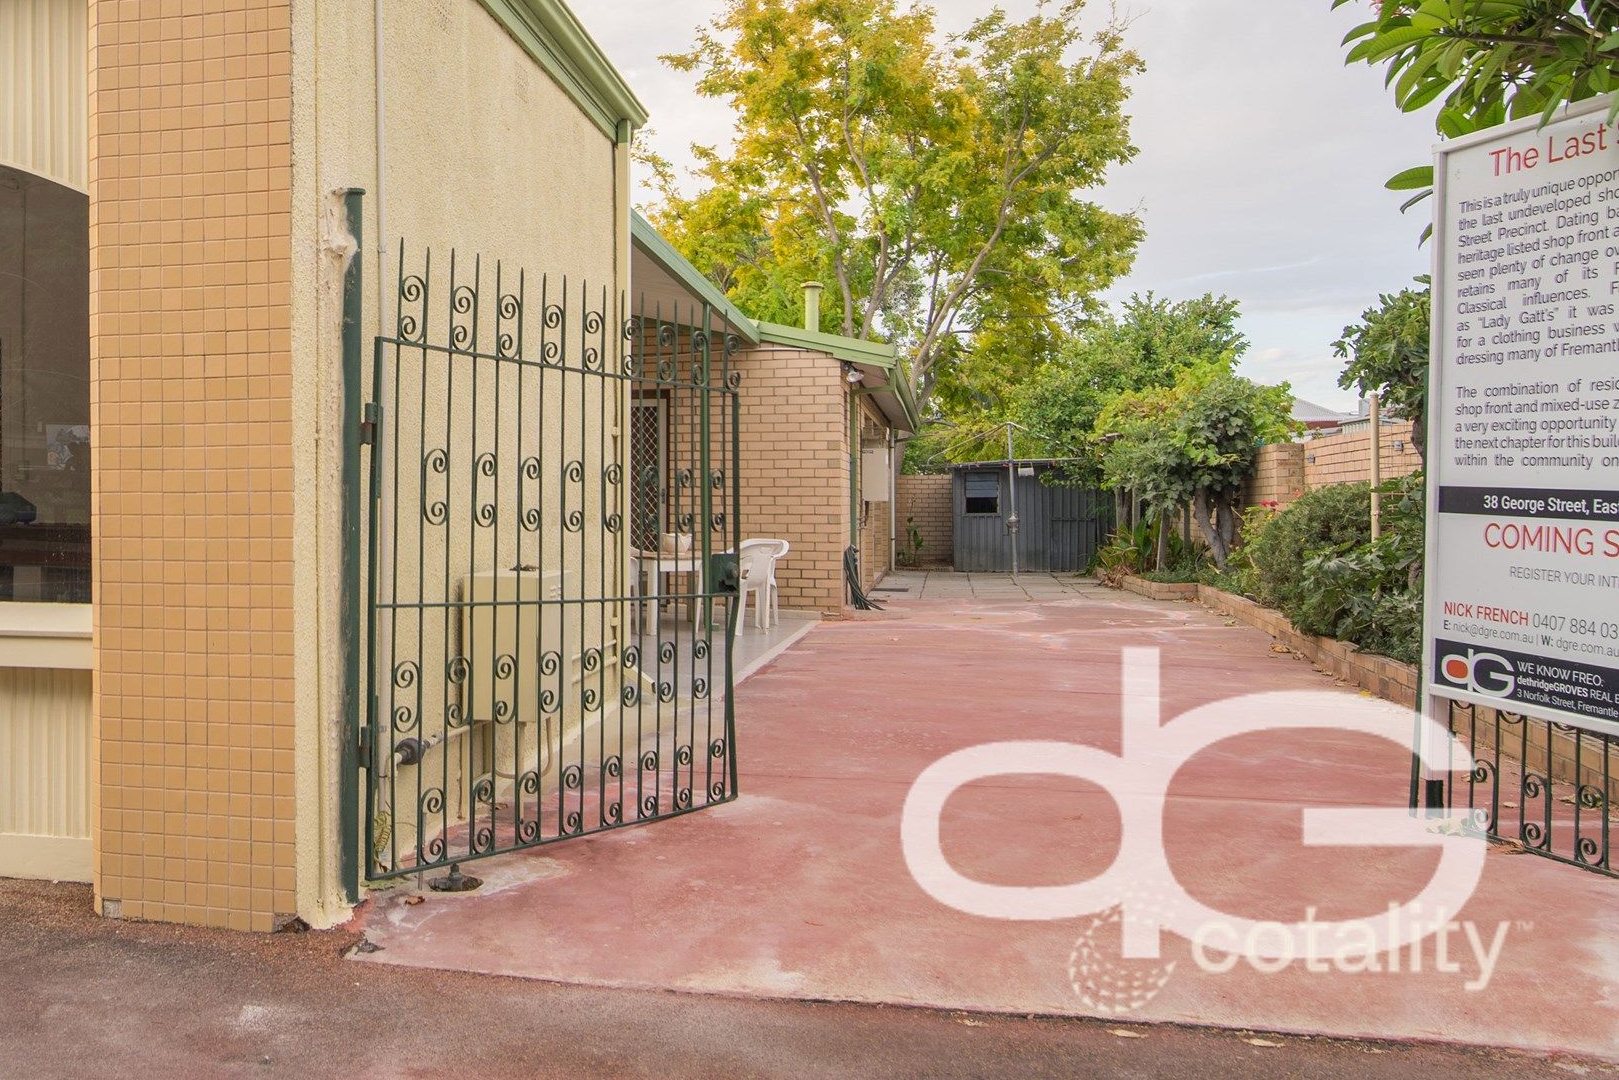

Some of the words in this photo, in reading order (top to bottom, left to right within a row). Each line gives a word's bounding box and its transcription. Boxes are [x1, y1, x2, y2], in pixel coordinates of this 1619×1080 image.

[1489, 147, 1539, 176] The
[1549, 123, 1607, 163] Last
[1459, 200, 1482, 214] This
[1483, 196, 1493, 209] is
[1494, 196, 1502, 207] a
[1503, 188, 1531, 205] truly
[1531, 179, 1576, 199] unique
[1459, 218, 1478, 231] the
[1482, 211, 1504, 227] last
[1508, 191, 1591, 222] undeveloped
[1458, 231, 1493, 248] Street
[1498, 220, 1550, 241] Precinct.
[1556, 211, 1599, 229] Dating
[1458, 247, 1505, 265] heritage
[1507, 238, 1540, 256] listed
[1542, 234, 1575, 251] shop
[1577, 226, 1610, 244] front
[1457, 268, 1485, 282] seen
[1489, 260, 1527, 279] plenty
[1531, 254, 1546, 270] of
[1549, 249, 1599, 267] change
[1457, 282, 1496, 298] retains
[1507, 276, 1542, 293] many
[1554, 270, 1569, 284] of
[1582, 266, 1599, 280] its
[1456, 296, 1507, 315] Classical
[1522, 288, 1591, 307] influences.
[1456, 320, 1471, 332] as
[1567, 305, 1577, 319] it
[1586, 303, 1615, 317] was
[1456, 335, 1473, 349] for
[1477, 336, 1486, 347] a
[1491, 329, 1541, 345] clothing
[1547, 323, 1606, 340] business
[1455, 350, 1505, 366] dressing
[1507, 347, 1542, 363] many
[1544, 343, 1559, 358] of
[1455, 386, 1478, 399] The
[1484, 381, 1559, 398] combination
[1567, 378, 1582, 393] of
[1455, 403, 1483, 418] shop
[1484, 401, 1513, 415] front
[1514, 399, 1538, 414] and
[1540, 398, 1610, 412] mixed-use
[1454, 421, 1462, 433] a
[1464, 421, 1489, 435] very
[1491, 417, 1537, 434] exciting
[1540, 415, 1617, 433] opportunity
[1454, 436, 1474, 449] the
[1474, 436, 1499, 449] next
[1500, 435, 1546, 452] chapter
[1547, 434, 1566, 449] for
[1567, 434, 1590, 449] this
[1454, 453, 1488, 466] within
[1494, 453, 1515, 466] the
[1521, 453, 1594, 471] community
[1483, 495, 1499, 509] 38
[1501, 495, 1545, 514] George
[1547, 496, 1590, 515] Street,
[1484, 522, 1595, 556] COMING
[1509, 566, 1562, 583] REGISTER
[1564, 571, 1596, 586] YOUR
[1443, 601, 1473, 619] NICK
[1476, 605, 1529, 627] FRENCH
[1532, 612, 1566, 632] 0407
[1569, 617, 1597, 636] 884
[1443, 619, 1451, 631] E:
[1453, 622, 1534, 644] nick@dgre.com.au
[1541, 634, 1554, 648] W:
[1517, 660, 1534, 676] WE
[1536, 664, 1571, 683] KNOW
[1516, 688, 1523, 698] 3
[1523, 689, 1550, 705] Norfolk
[1577, 700, 1619, 719] Fremantle
[1517, 675, 1589, 698] dethridgeGROVES
[1590, 688, 1613, 704] REAL
